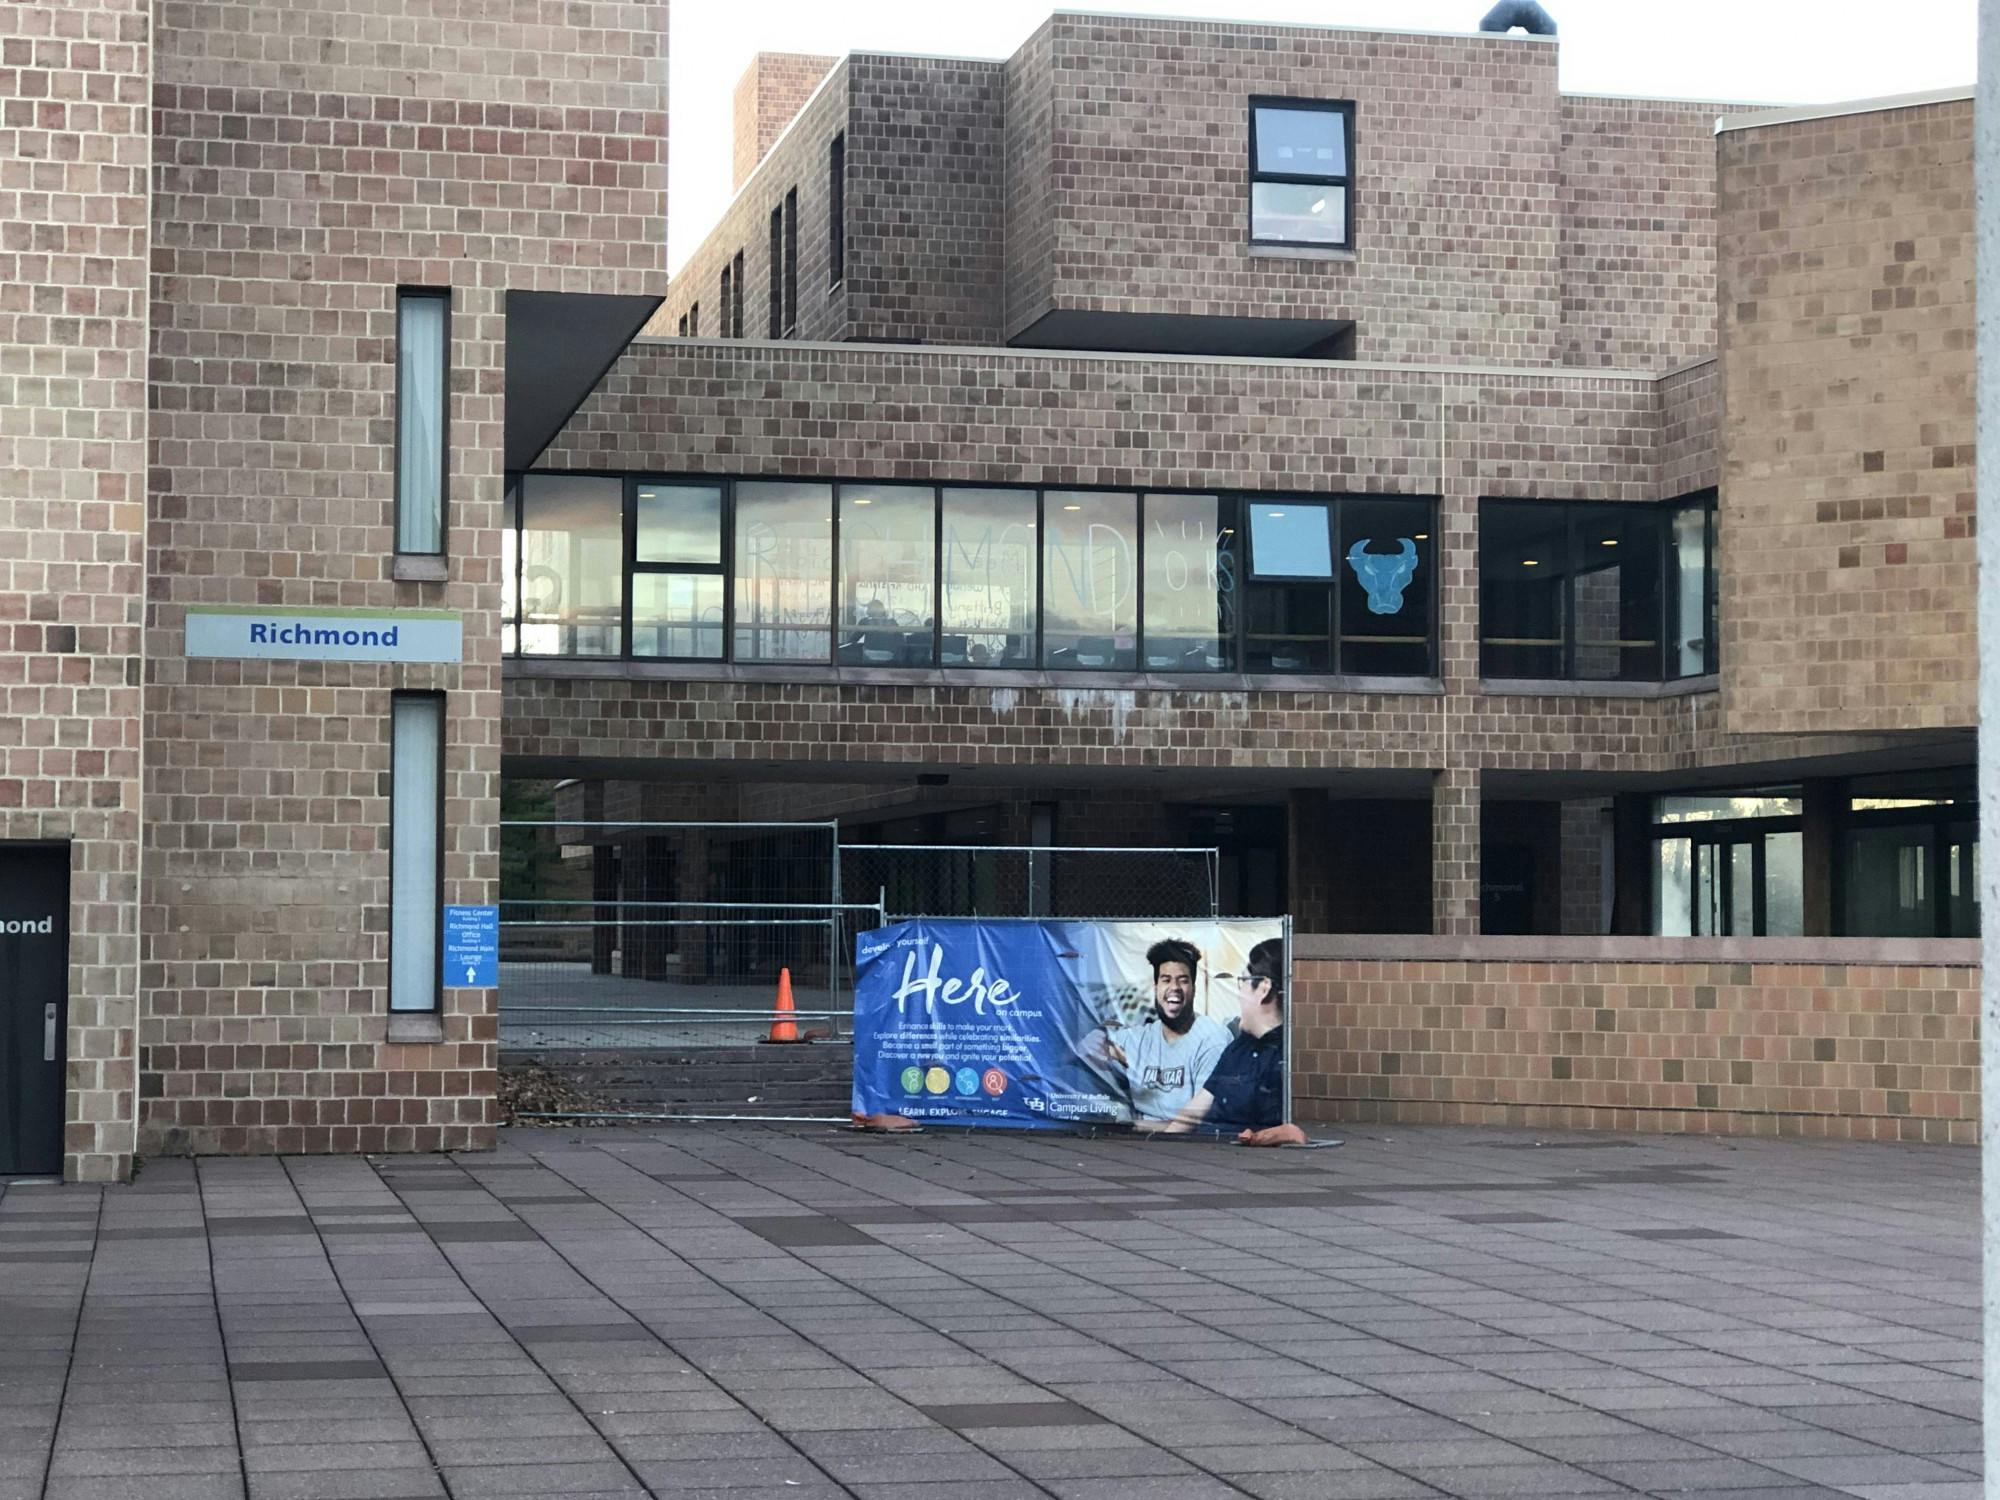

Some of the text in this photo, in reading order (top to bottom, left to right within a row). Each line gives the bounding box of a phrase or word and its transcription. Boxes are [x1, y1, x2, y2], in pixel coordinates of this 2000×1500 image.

[250, 623, 398, 647] Richmond
[449, 909, 494, 917] Fitness Center
[896, 935, 931, 949] yourself
[892, 943, 1021, 1015] Here
[995, 1009, 1043, 1019] on campus
[898, 1022, 929, 1030] Enhance
[930, 1022, 946, 1030] skills
[955, 1022, 975, 1031] make
[976, 1024, 993, 1033] your
[873, 1031, 898, 1041] Explore
[899, 1031, 938, 1040] differences
[939, 1032, 958, 1041] while
[958, 1032, 999, 1043] celebrating
[882, 1040, 913, 1050] Become
[921, 1041, 938, 1050] small
[938, 1042, 954, 1053] part
[955, 1042, 963, 1050] of
[963, 1043, 1001, 1053] something
[877, 1050, 909, 1059] Discover
[917, 1052, 930, 1060] new
[931, 1053, 944, 1061] you
[945, 1052, 960, 1060] and
[960, 1053, 980, 1063] ignite
[981, 1054, 997, 1062] your
[1022, 1097, 1045, 1112] UB
[1049, 1102, 1119, 1116] Campus Living
